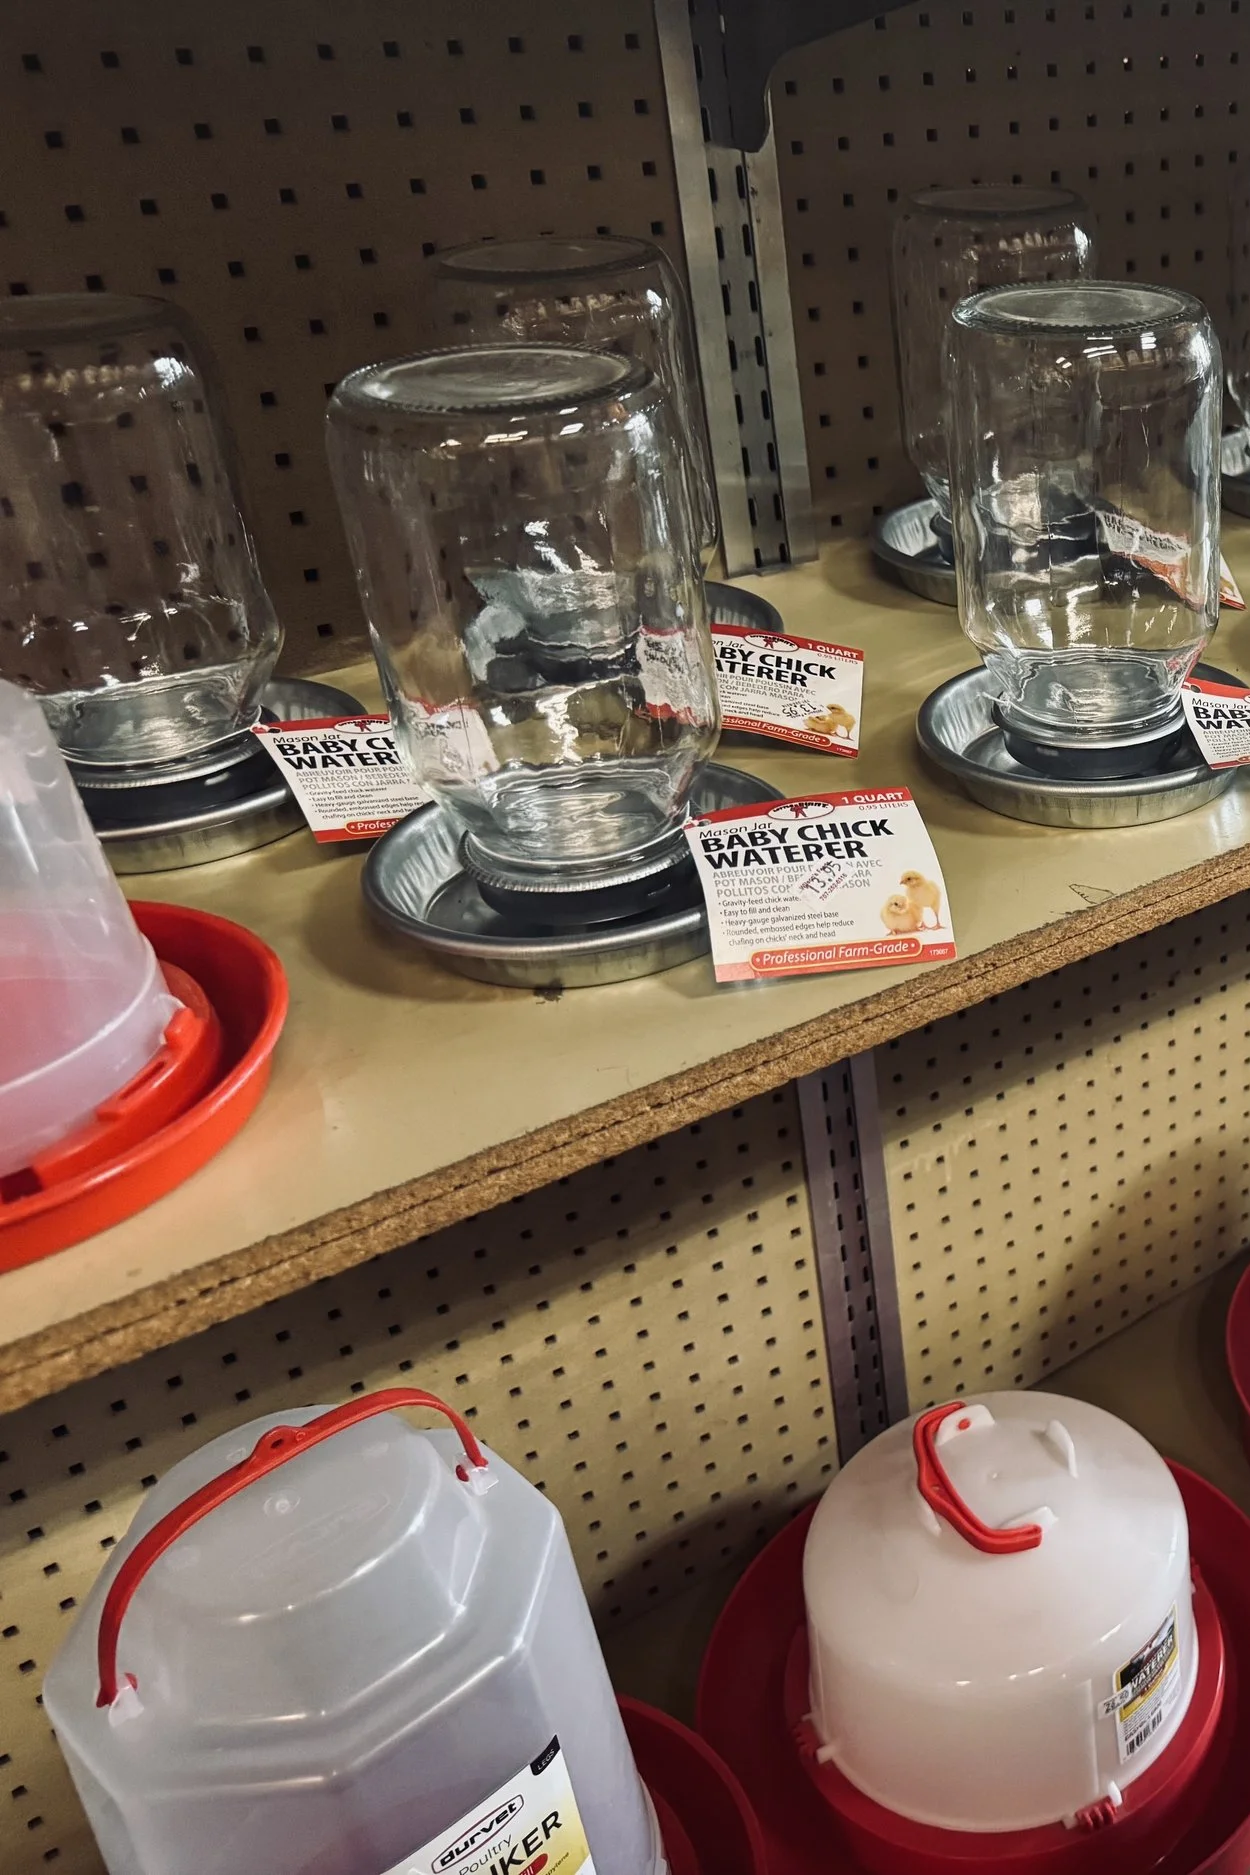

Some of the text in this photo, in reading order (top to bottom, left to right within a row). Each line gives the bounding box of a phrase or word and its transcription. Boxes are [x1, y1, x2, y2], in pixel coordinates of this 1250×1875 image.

[726, 640, 744, 648] Jar
[816, 645, 858, 659] QUART
[714, 646, 836, 680] BY CHICK
[716, 659, 808, 687] ATERER
[729, 674, 754, 683] POUR
[755, 678, 793, 690] POUSSIN
[794, 685, 816, 696] AVEC
[736, 680, 780, 693] BEBEDERO
[782, 689, 804, 698] PARA
[1191, 697, 1248, 710] Mason Jar
[273, 733, 341, 744] Mason Jar
[762, 723, 820, 743] Farm-Grade
[276, 739, 358, 756] BABY
[284, 752, 402, 770] WATER
[296, 769, 353, 778] ABREUVOIR
[354, 767, 381, 776] POUR
[321, 774, 358, 783] MASON
[365, 772, 408, 780] BEBEDER
[352, 780, 373, 788] CON
[842, 791, 903, 804] 1 QUART
[859, 802, 909, 811] 0.95 LITERS
[699, 821, 774, 839] Mason Jar
[701, 818, 894, 853] BABY CHICK
[704, 839, 868, 870] WATERER
[713, 867, 775, 879] ABREUVOIR
[777, 865, 807, 874] POUR
[857, 859, 883, 868] AVEC
[804, 862, 841, 894] 13.95
[714, 879, 736, 888] POT
[740, 876, 779, 887] MASON
[716, 886, 769, 898] POLLITOS
[841, 878, 871, 888] ASON
[722, 898, 764, 907] Gravity-feed
[723, 909, 738, 917] Easy
[725, 917, 769, 927] Heavy-gauge
[770, 913, 806, 924] galvanized
[824, 910, 839, 918] base
[726, 918, 854, 937] Rounded, embossed edges help reduce
[728, 937, 754, 946] chafing
[765, 934, 788, 942] chicks'
[819, 929, 836, 937] head
[763, 942, 909, 966] Professional Farm-Grade
[537, 1750, 556, 1771] LEGS
[439, 1802, 518, 1868] durvet
[459, 1834, 513, 1875] Poultry
